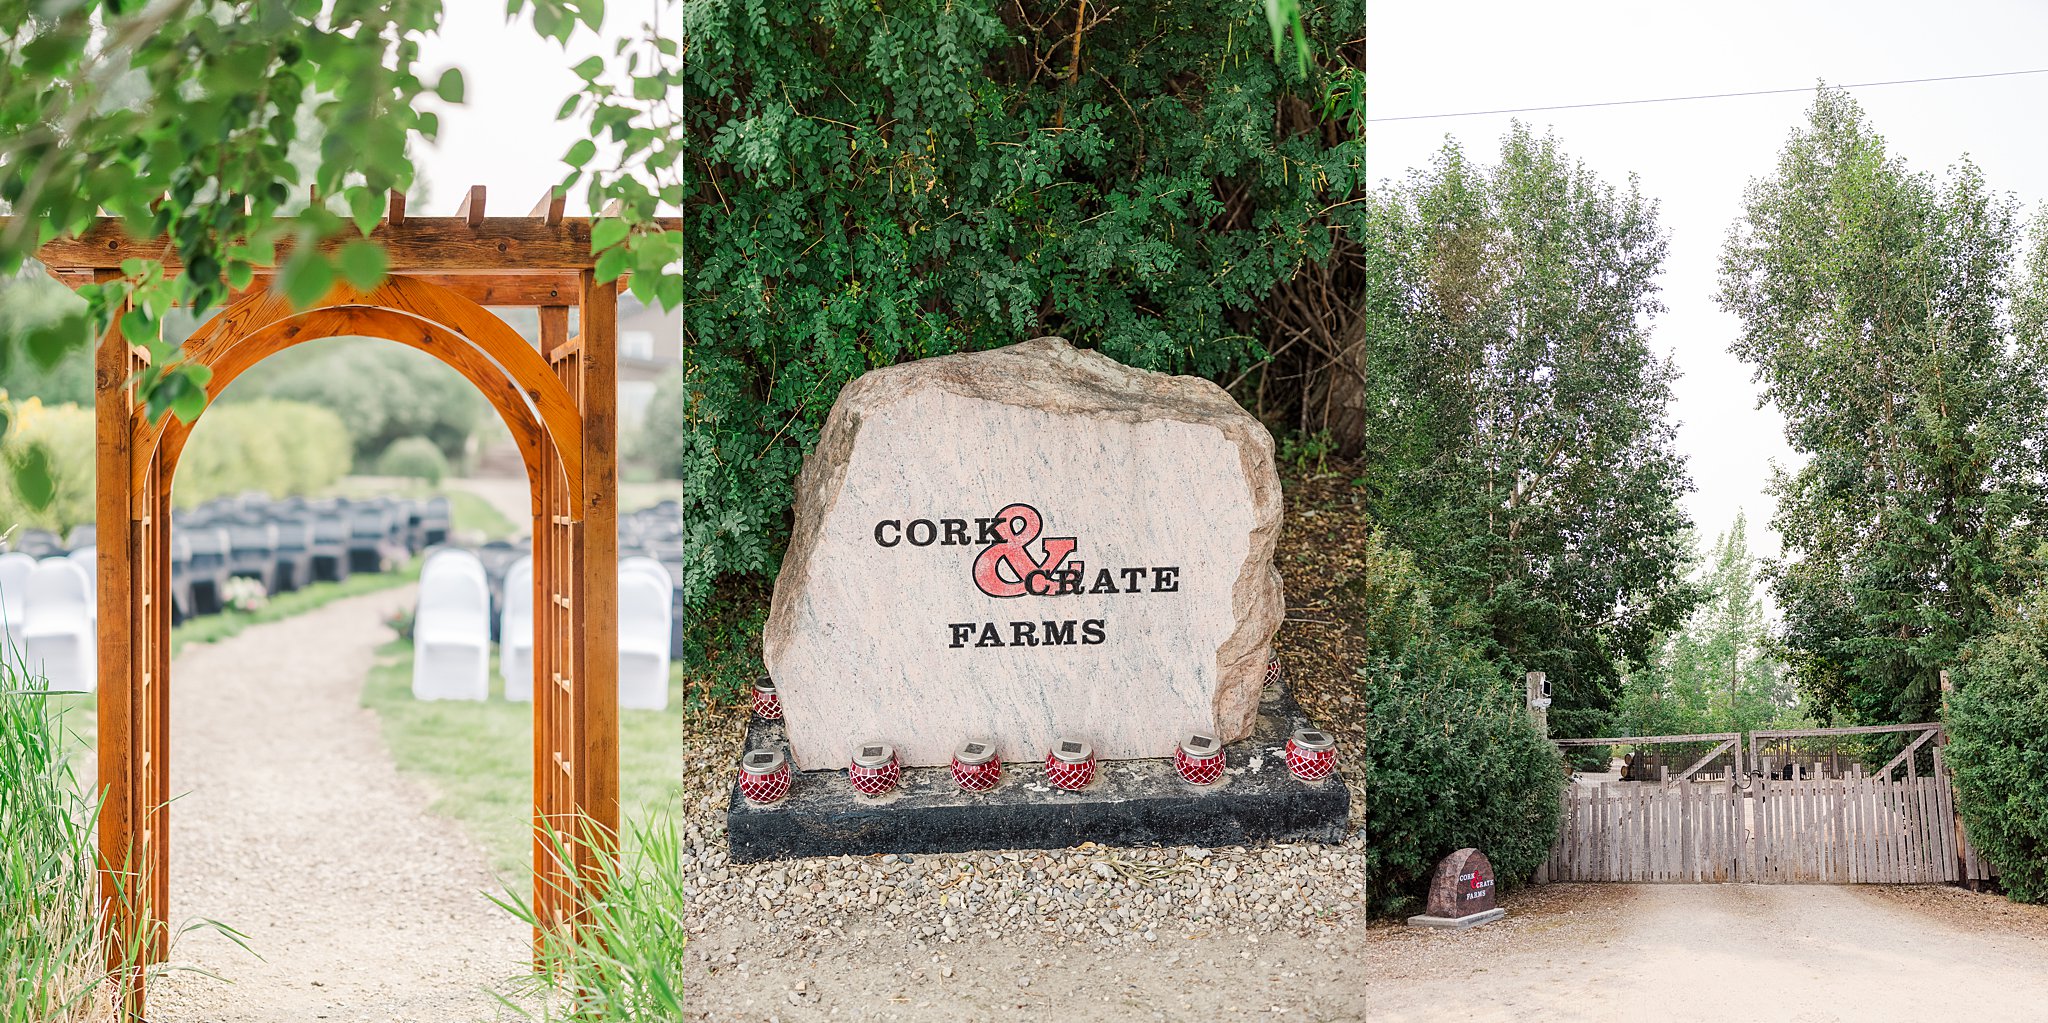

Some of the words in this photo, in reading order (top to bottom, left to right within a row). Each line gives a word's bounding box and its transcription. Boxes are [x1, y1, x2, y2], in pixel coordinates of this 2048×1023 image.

[873, 516, 1008, 548] CORK
[971, 502, 1085, 598] &
[1023, 566, 1180, 596] CRATE
[948, 618, 1107, 649] FARMS
[1459, 872, 1475, 882] CORK
[1475, 879, 1494, 888] CRATE
[1466, 890, 1486, 900] FARMS
